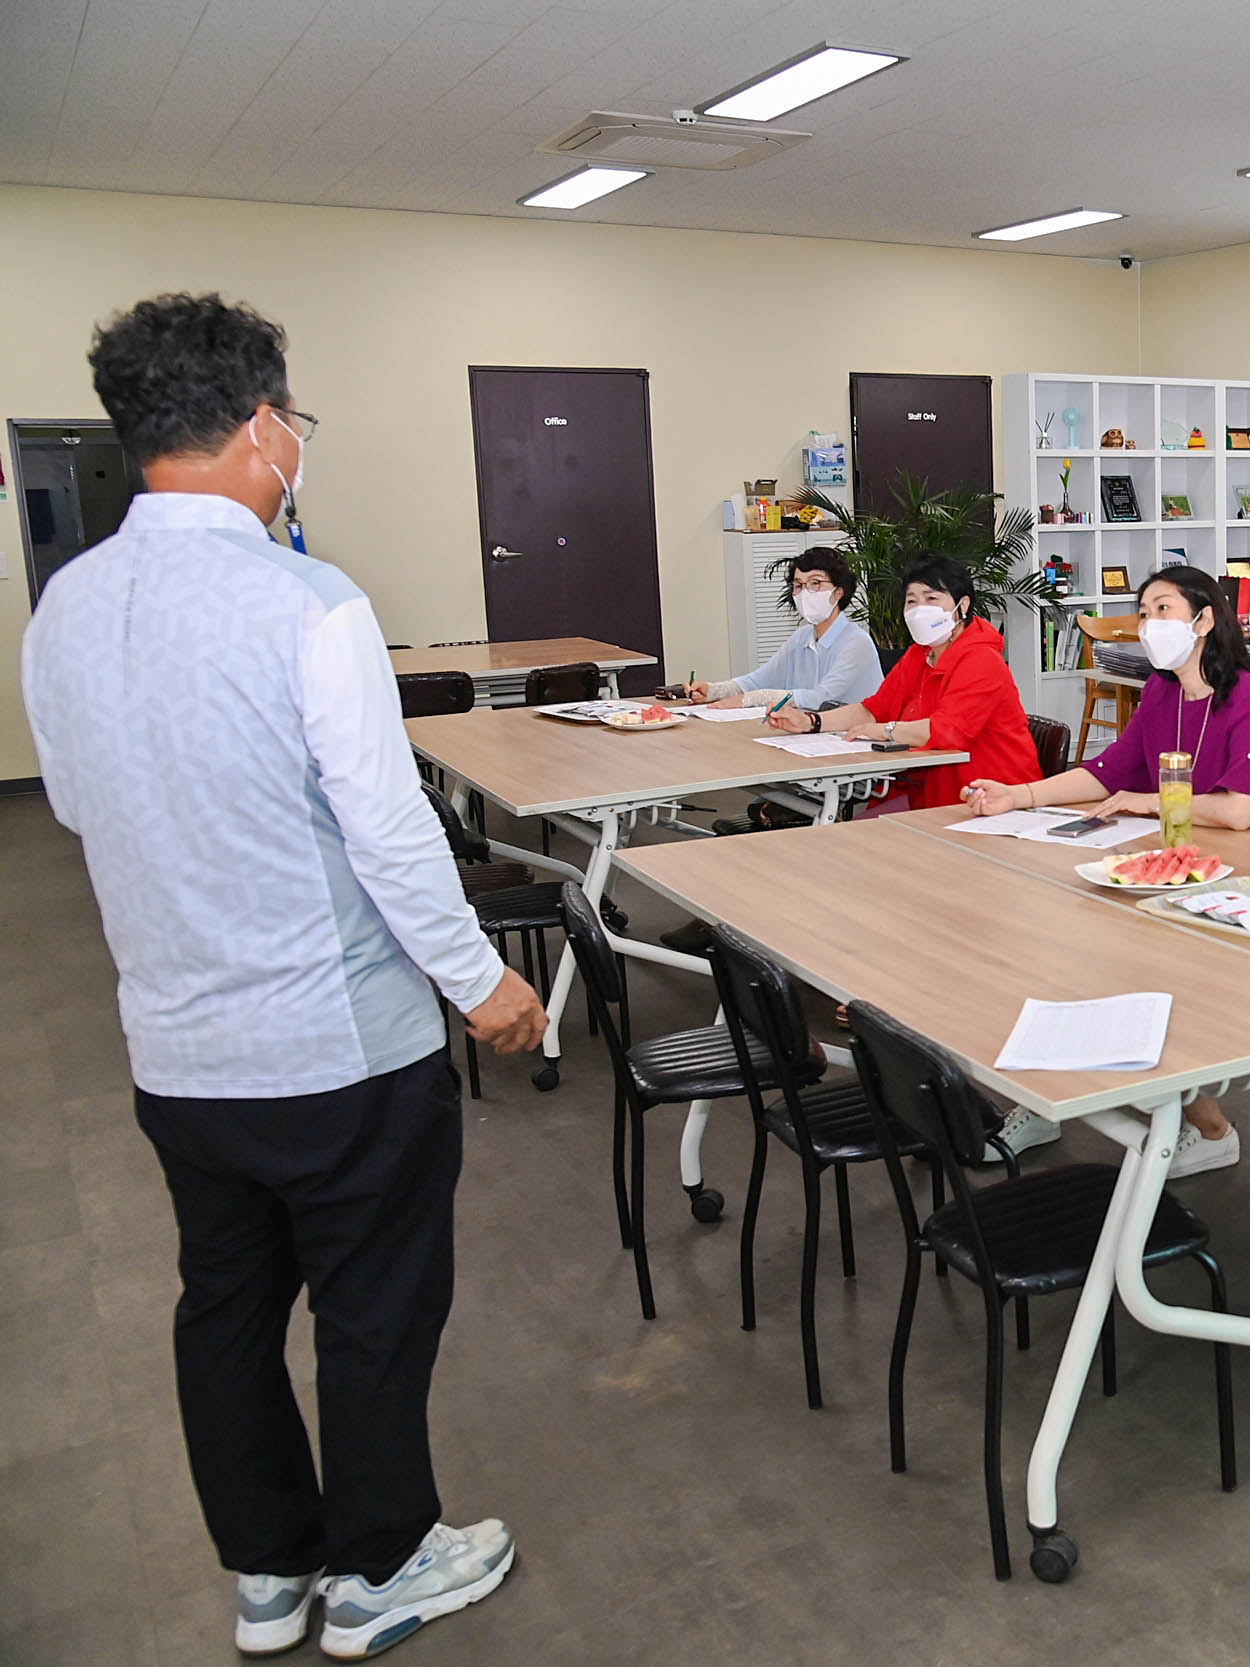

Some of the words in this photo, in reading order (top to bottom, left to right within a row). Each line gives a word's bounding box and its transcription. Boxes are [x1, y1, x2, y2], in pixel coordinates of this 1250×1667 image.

[544, 416, 568, 426] Office
[907, 412, 922, 421] Staff
[923, 412, 937, 422] Only
